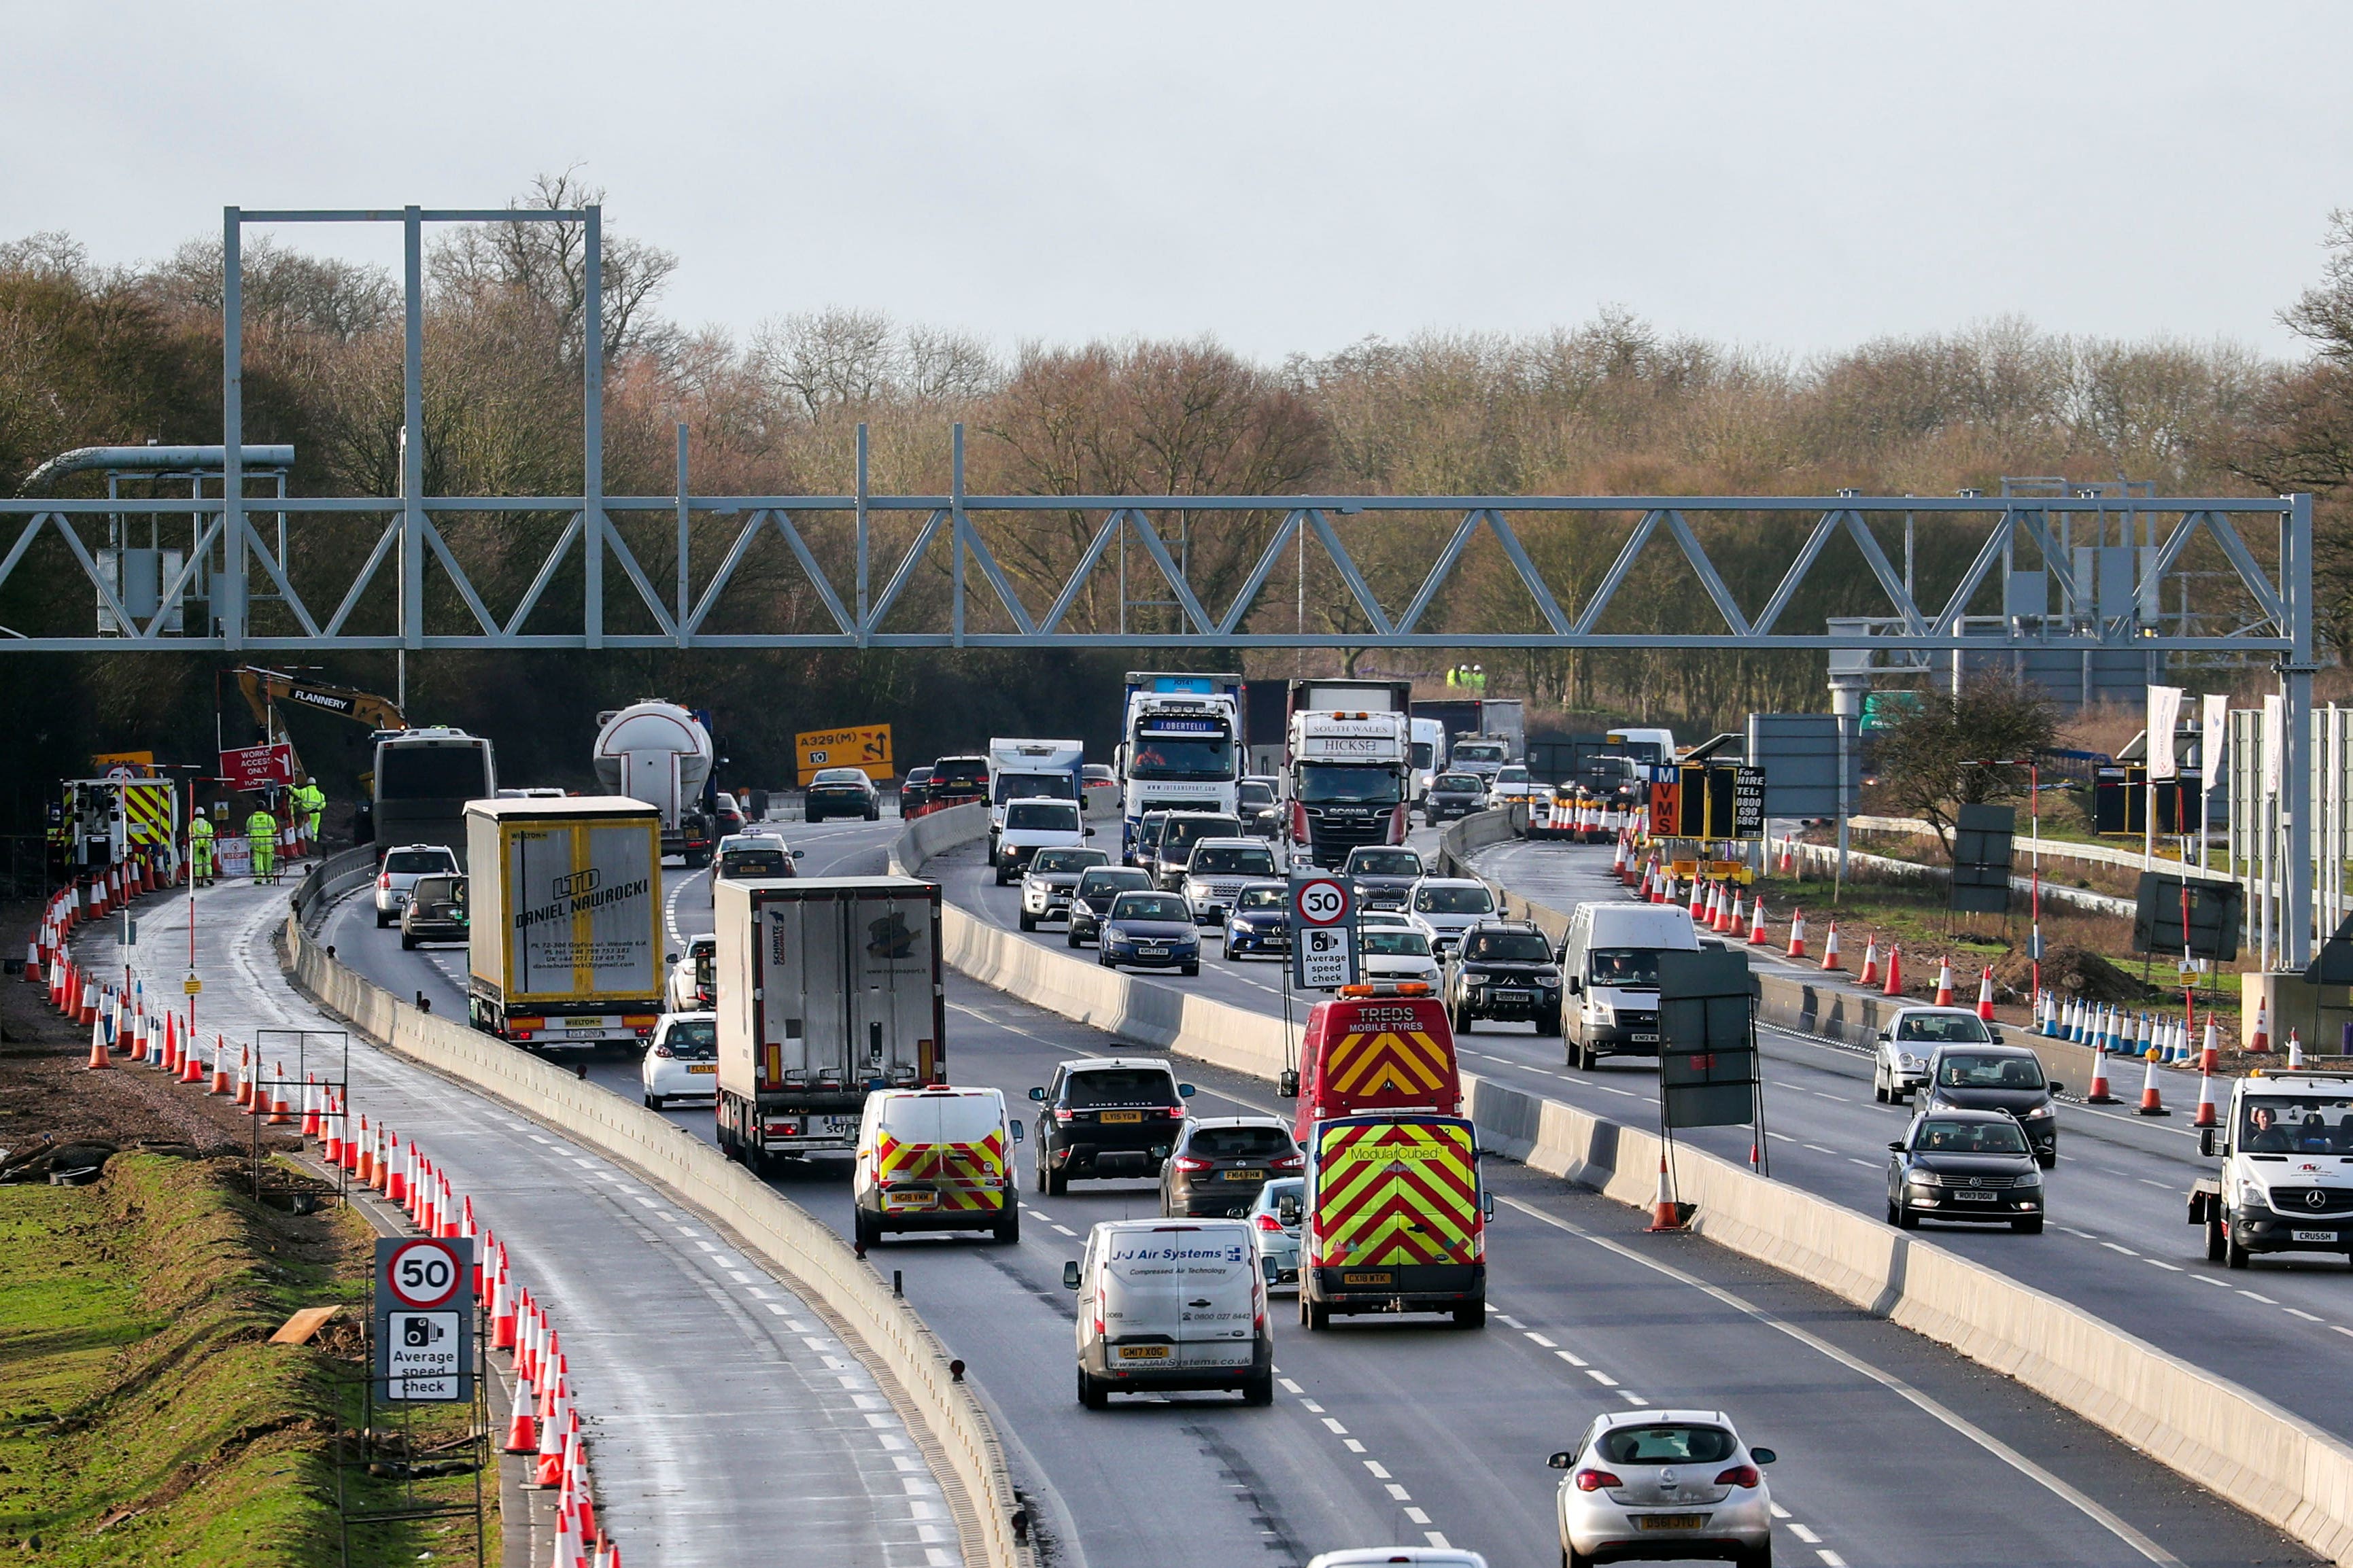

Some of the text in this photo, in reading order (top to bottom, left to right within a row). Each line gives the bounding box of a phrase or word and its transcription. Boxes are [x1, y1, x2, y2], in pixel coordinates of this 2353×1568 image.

[295, 690, 347, 710] FLANNERY
[1160, 722, 1206, 731] J.OBERTELLI
[1352, 725, 1388, 733] WALES
[800, 732, 857, 746] A329(M)
[1325, 739, 1366, 751] HICKS
[241, 750, 271, 759] WORKS
[812, 753, 824, 763] 10
[247, 767, 269, 776] ONLY
[1738, 767, 1755, 776] For
[1736, 786, 1759, 795] TEL:
[1736, 797, 1762, 807] 0800
[1329, 807, 1369, 816] SCANIA
[1738, 807, 1758, 816] 690
[553, 868, 600, 901] LTD
[515, 879, 648, 928] DANIEL NAWROCKI
[1307, 892, 1339, 912] 50
[1305, 954, 1347, 963] Average
[1311, 964, 1341, 974] speed
[1312, 974, 1342, 983] check
[1358, 1007, 1414, 1022] TREDS
[1349, 1022, 1423, 1032] MOBILE TYRES
[1137, 1249, 1158, 1259] Air
[1162, 1249, 1222, 1262] Systems
[402, 1259, 449, 1288] 50
[1188, 1267, 1226, 1275] Technology
[393, 1351, 454, 1365] Average
[402, 1367, 445, 1377] speed
[402, 1380, 445, 1393] check
